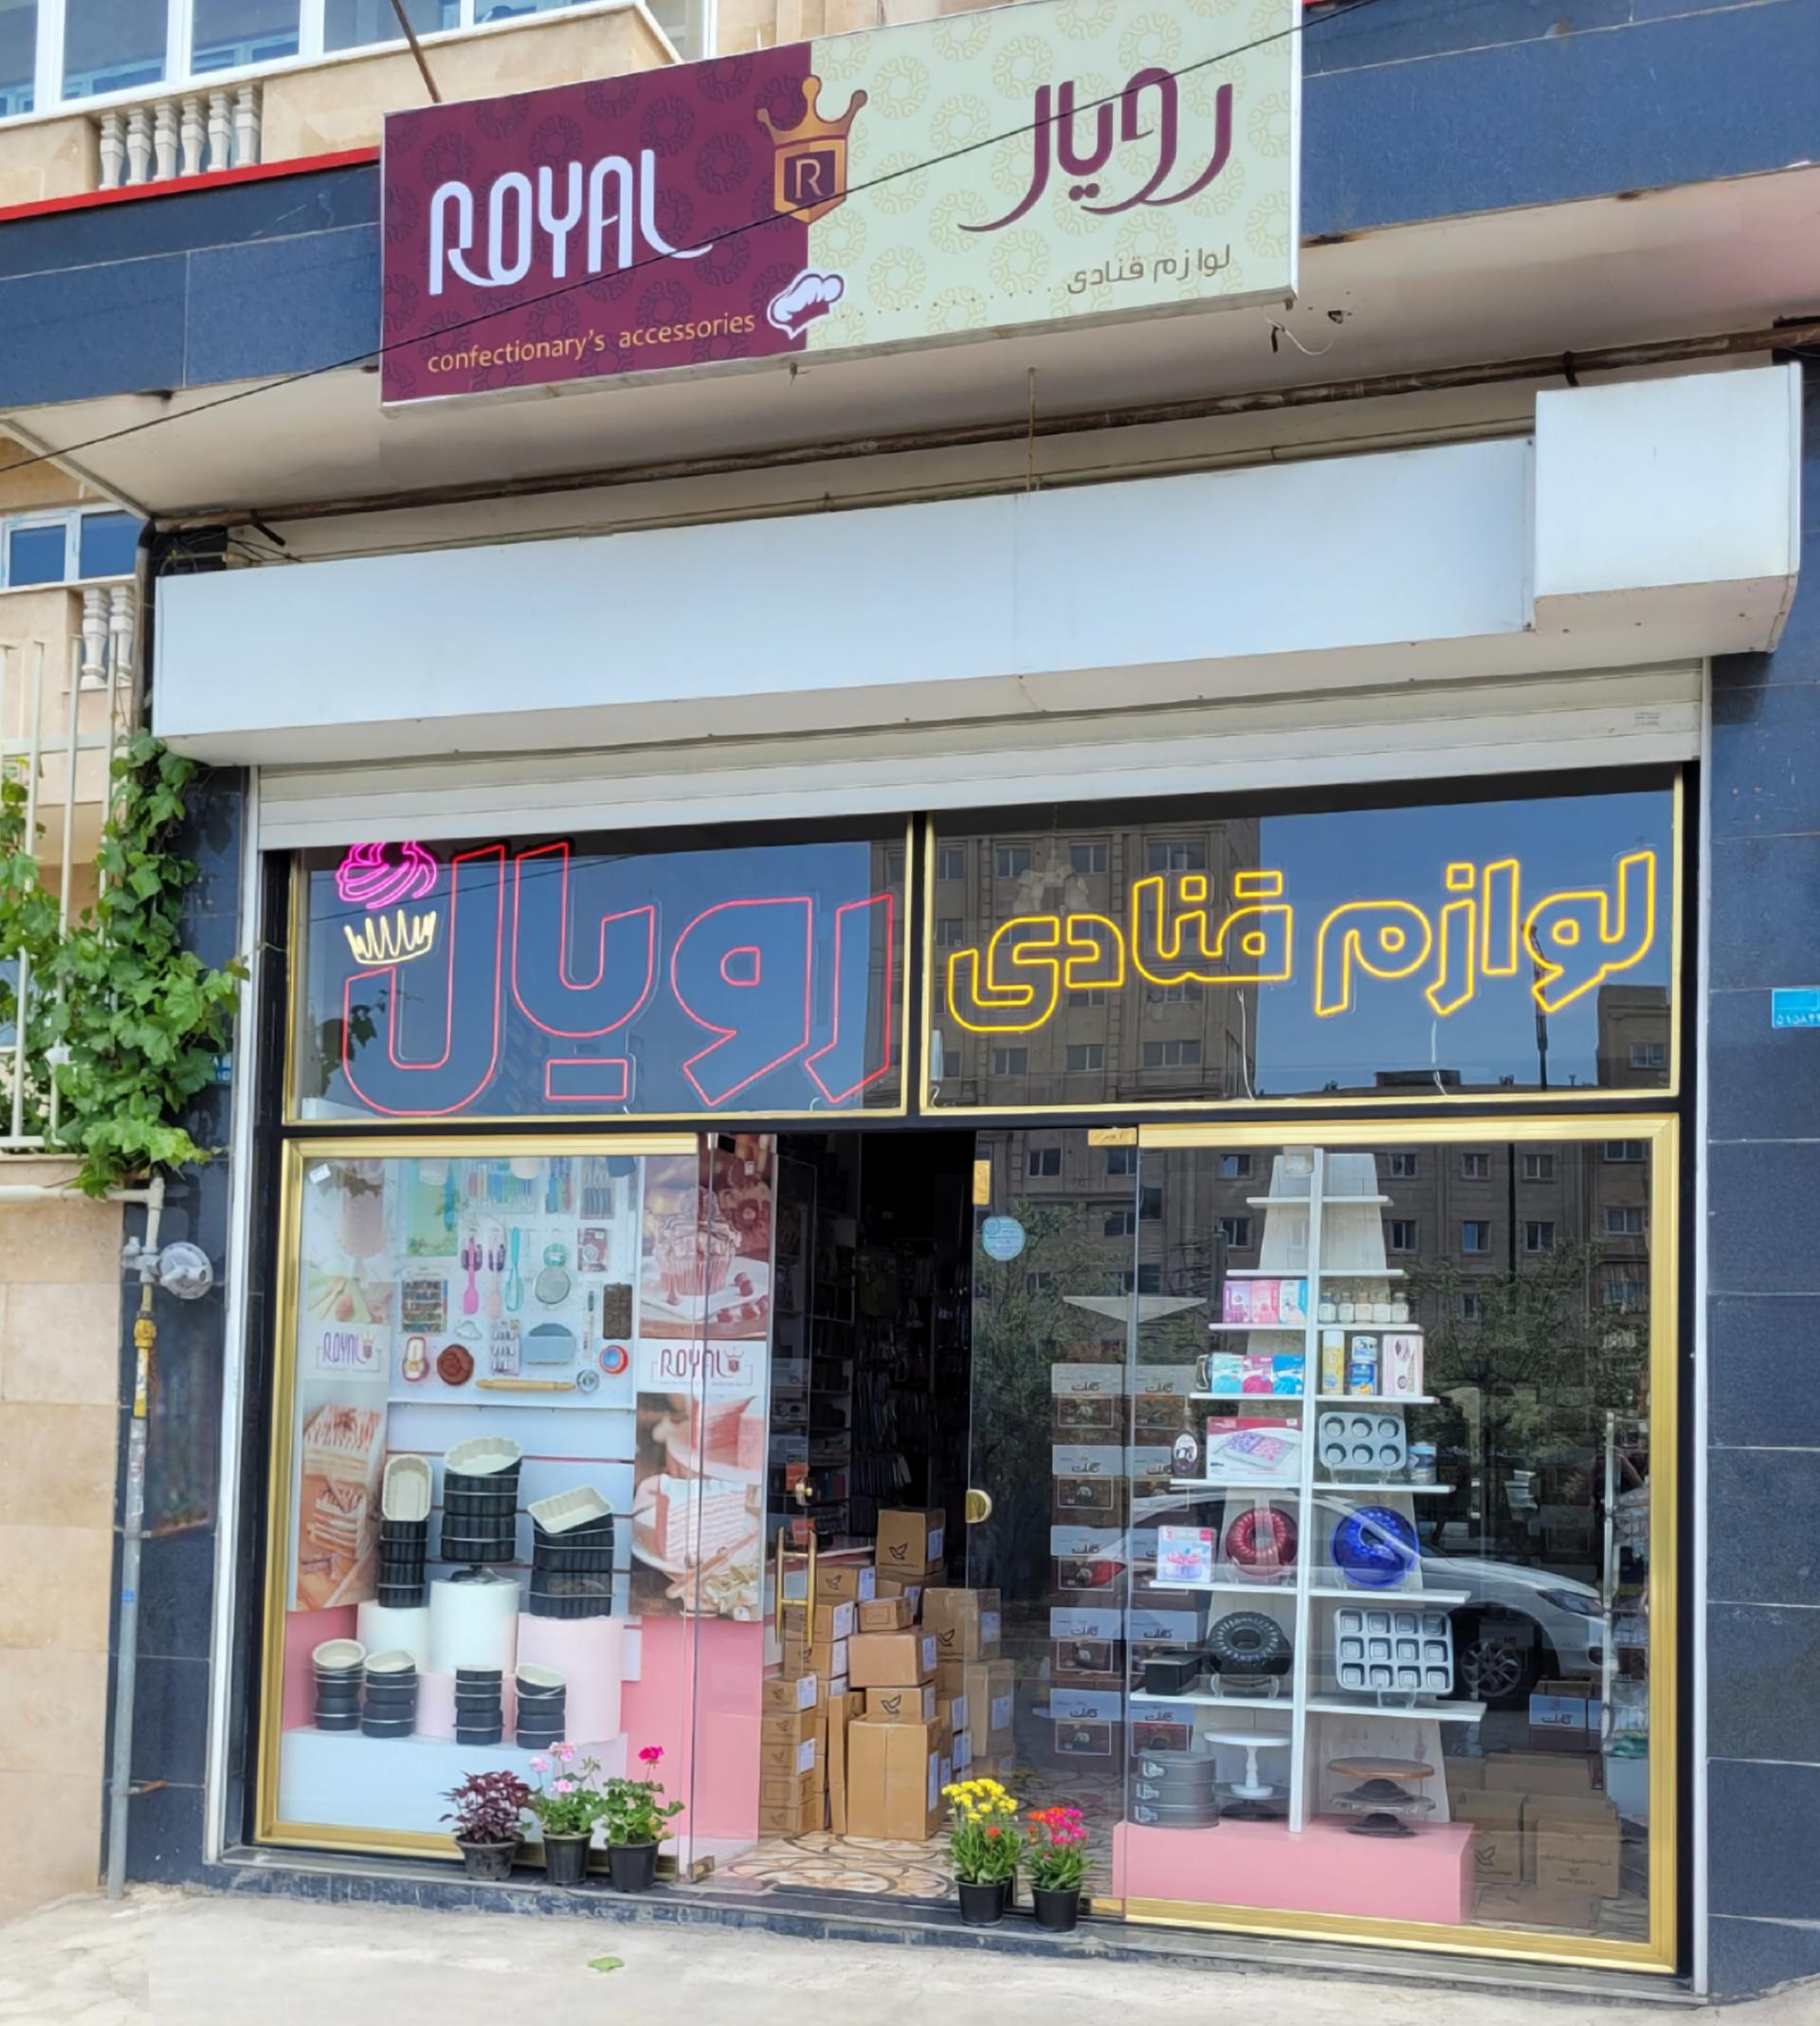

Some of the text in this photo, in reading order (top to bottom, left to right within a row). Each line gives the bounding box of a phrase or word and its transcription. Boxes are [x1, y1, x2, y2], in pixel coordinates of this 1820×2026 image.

[794, 158, 821, 199] R
[957, 67, 1232, 232] رویال
[428, 149, 713, 295] ROYAL
[1067, 244, 1230, 294] لوازم قنادی
[428, 313, 755, 373] confectionary's accessories
[342, 841, 893, 1116] رویال
[947, 850, 1656, 1033] لوازم قنادی
[661, 1348, 735, 1378] ROYAL
